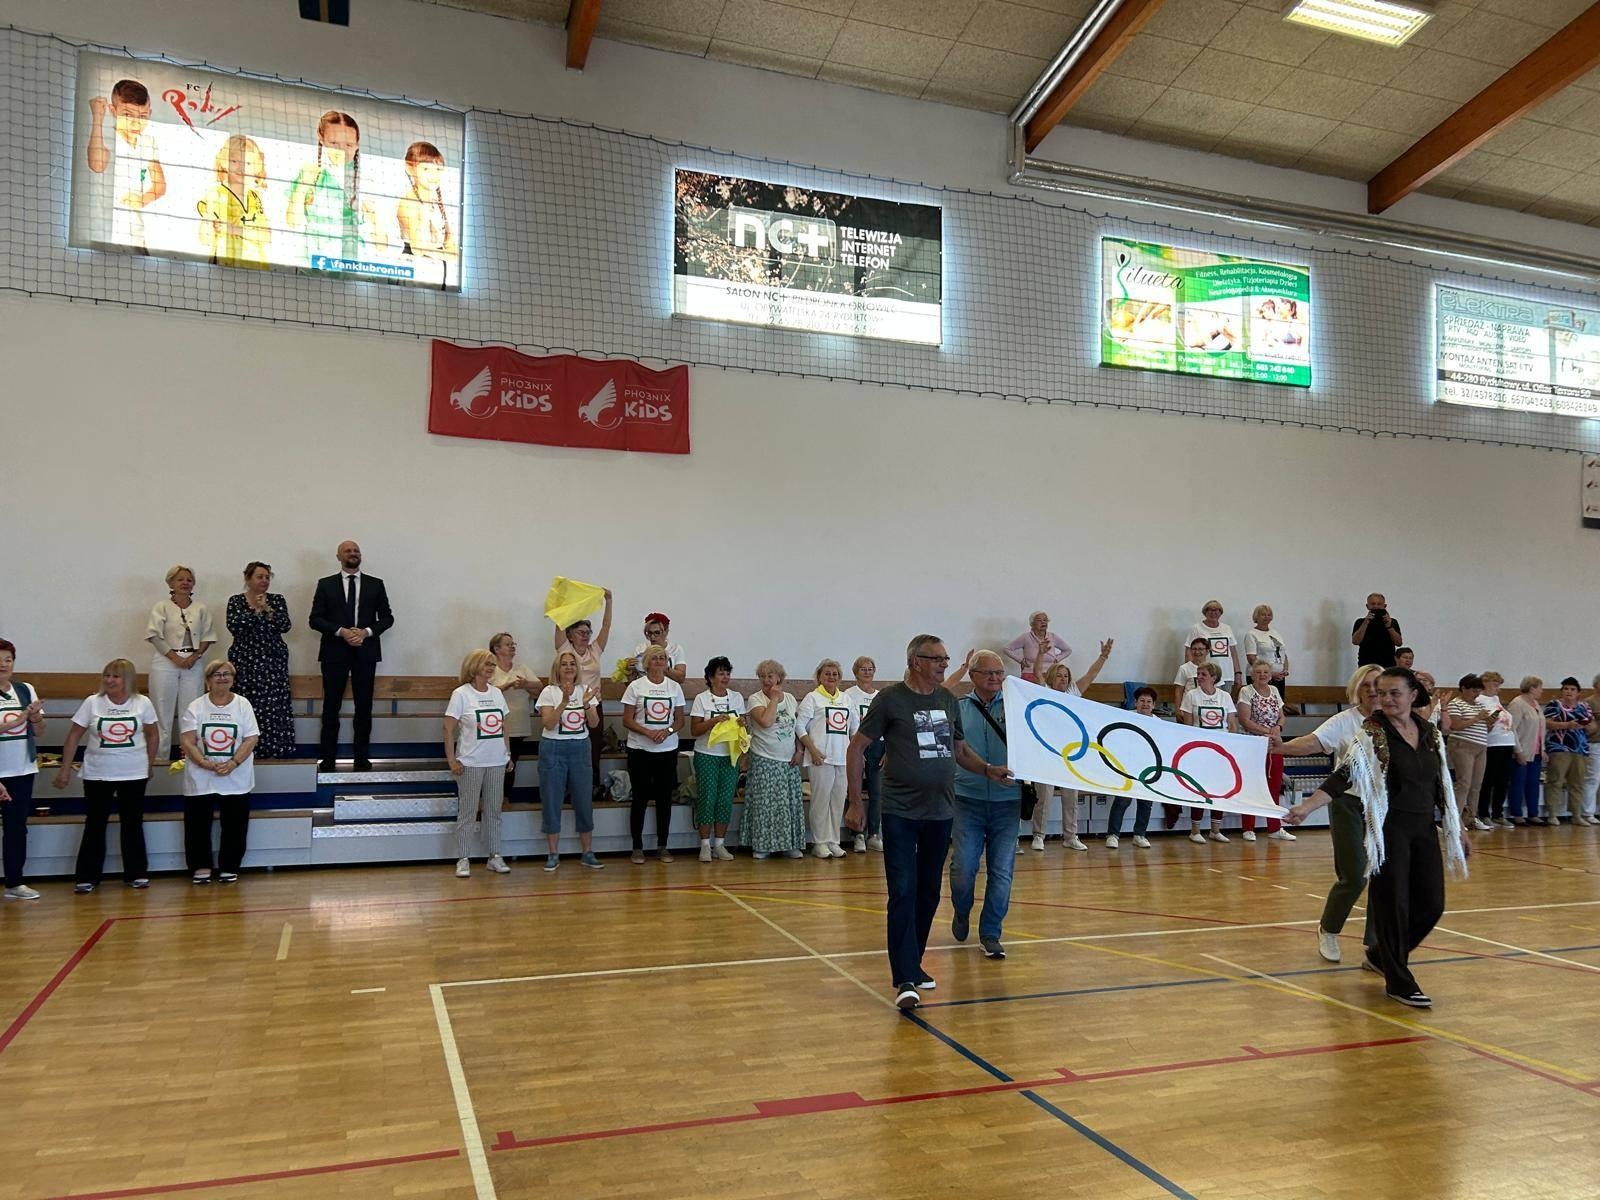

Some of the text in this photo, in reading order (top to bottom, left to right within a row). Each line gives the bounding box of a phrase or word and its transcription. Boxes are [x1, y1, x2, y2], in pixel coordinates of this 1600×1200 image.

[186, 83, 200, 92] FC
[734, 213, 828, 258] nc+
[840, 226, 903, 245] TELEWIZJA
[841, 240, 897, 257] INTERNET
[840, 253, 890, 271] TELEFON
[726, 287, 760, 299] SALON
